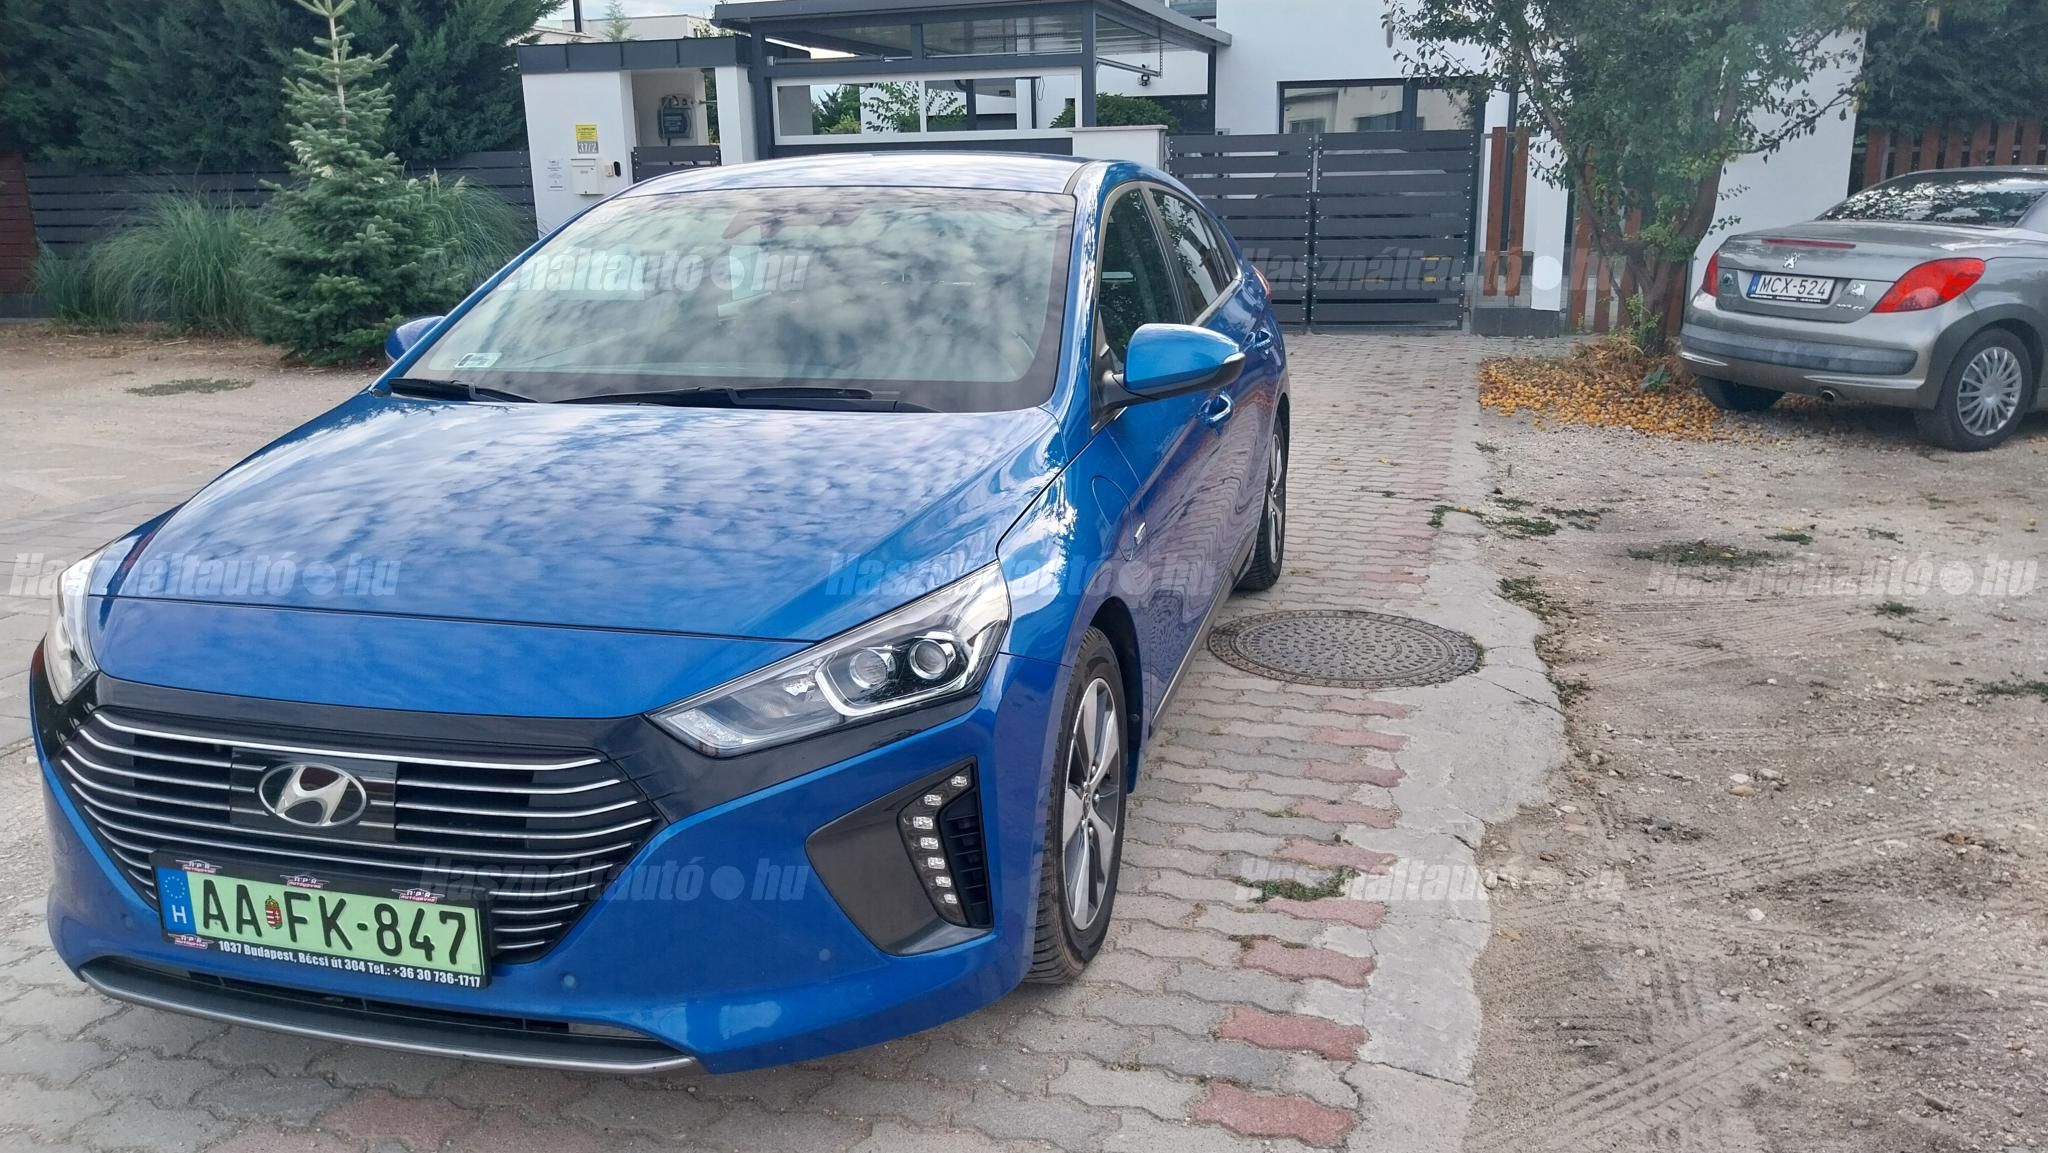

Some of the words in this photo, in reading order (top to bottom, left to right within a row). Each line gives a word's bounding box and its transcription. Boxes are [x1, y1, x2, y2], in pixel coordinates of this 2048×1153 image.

[1759, 277, 1828, 296] MCX-524
[172, 906, 188, 925] H
[218, 940, 241, 954] 1037
[244, 944, 297, 963] Budapest,
[299, 952, 329, 967] Bécsi
[331, 957, 343, 969] út
[367, 962, 391, 976] Tel.:
[393, 966, 414, 979] +36
[417, 969, 431, 981] 30
[433, 971, 480, 988] 736-1717
